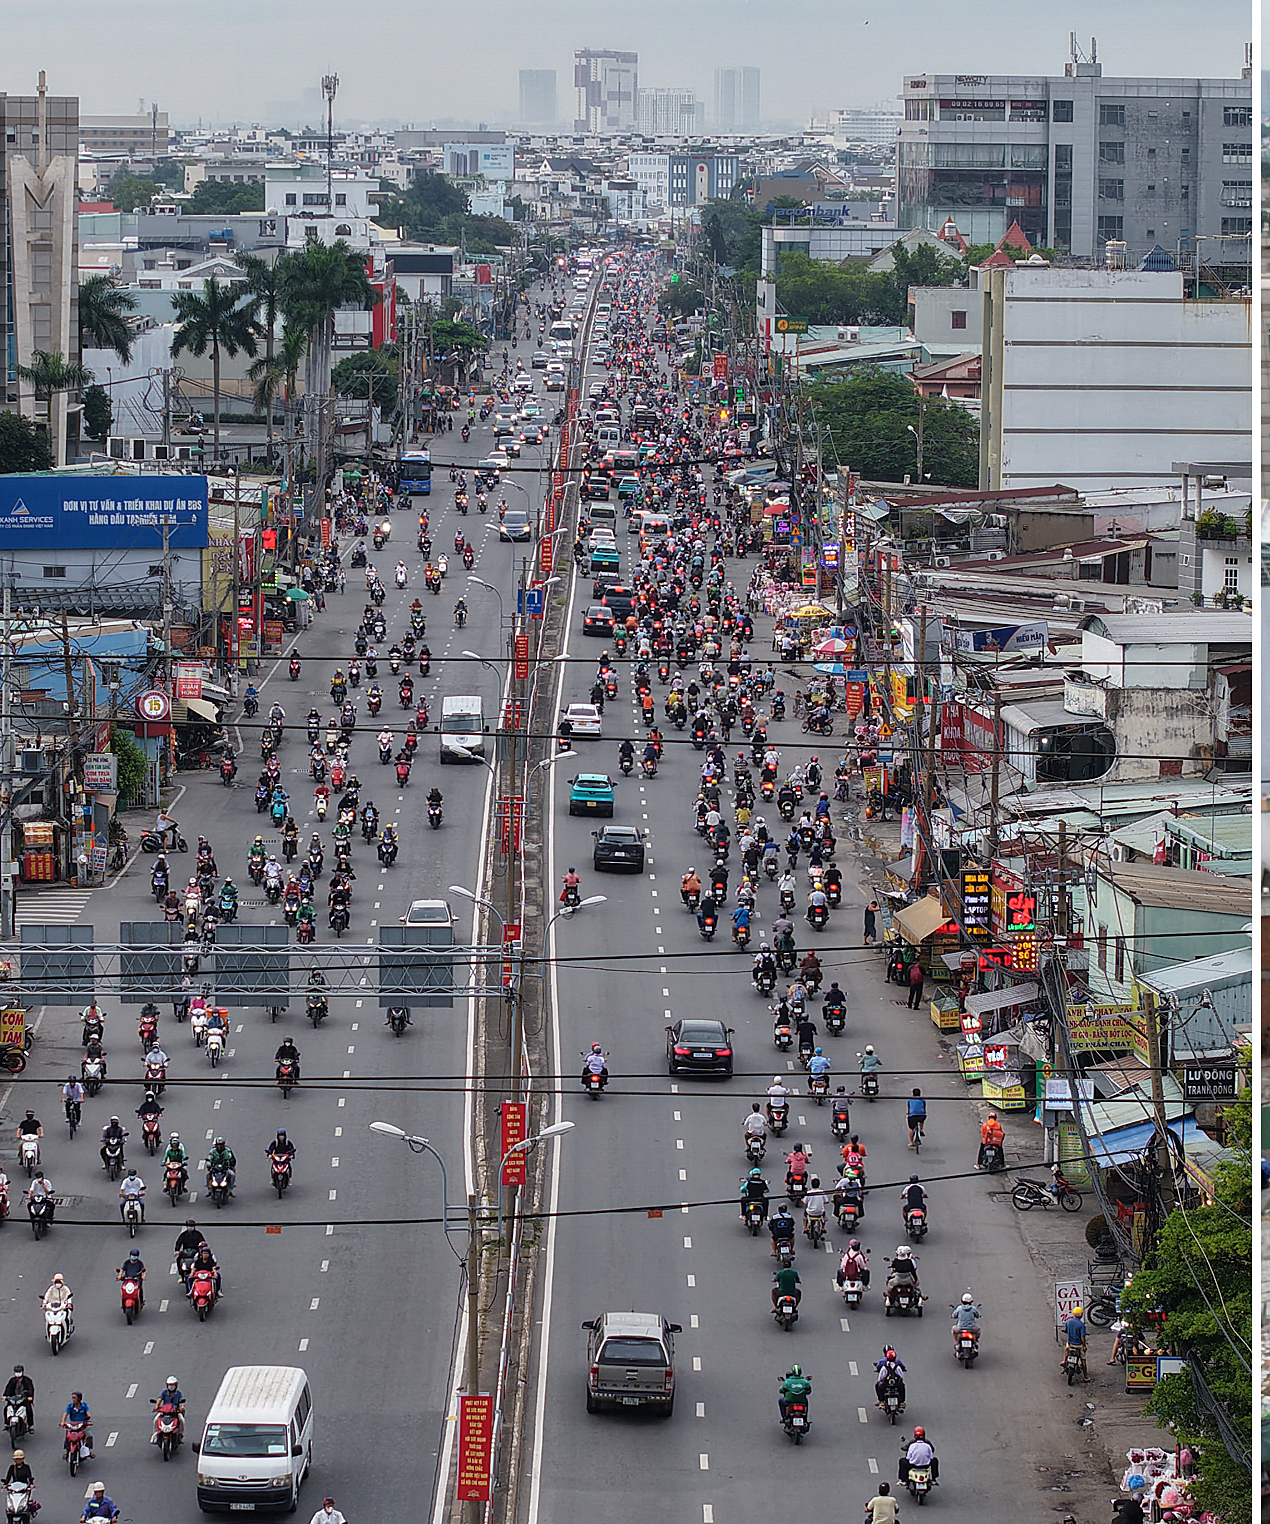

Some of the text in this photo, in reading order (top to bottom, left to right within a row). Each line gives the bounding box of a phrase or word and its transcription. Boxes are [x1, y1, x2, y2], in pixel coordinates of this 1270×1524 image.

[765, 202, 851, 217] Sacombank
[63, 500, 78, 511] ĐƠN
[79, 500, 88, 514] VỊ
[89, 500, 100, 511] TƯ
[100, 498, 116, 511] VẤN
[116, 502, 122, 511] &
[124, 498, 144, 511] TRIỂN
[145, 501, 163, 511] KHAI
[163, 500, 174, 513] DỰ
[176, 498, 186, 511] ÁN
[89, 512, 109, 525] HÀNG
[110, 512, 124, 525] ĐẦU
[148, 699, 161, 711] 15
[964, 906, 988, 914] LAPTOP
[2, 1011, 24, 1026] CƠM
[1067, 1007, 1082, 1017] ÁNH
[2, 1026, 23, 1044] TẤM
[1187, 1081, 1233, 1095] TRANH ĐỒNG
[1057, 1285, 1080, 1299] GÀ
[1057, 1300, 1083, 1314] VỊT
